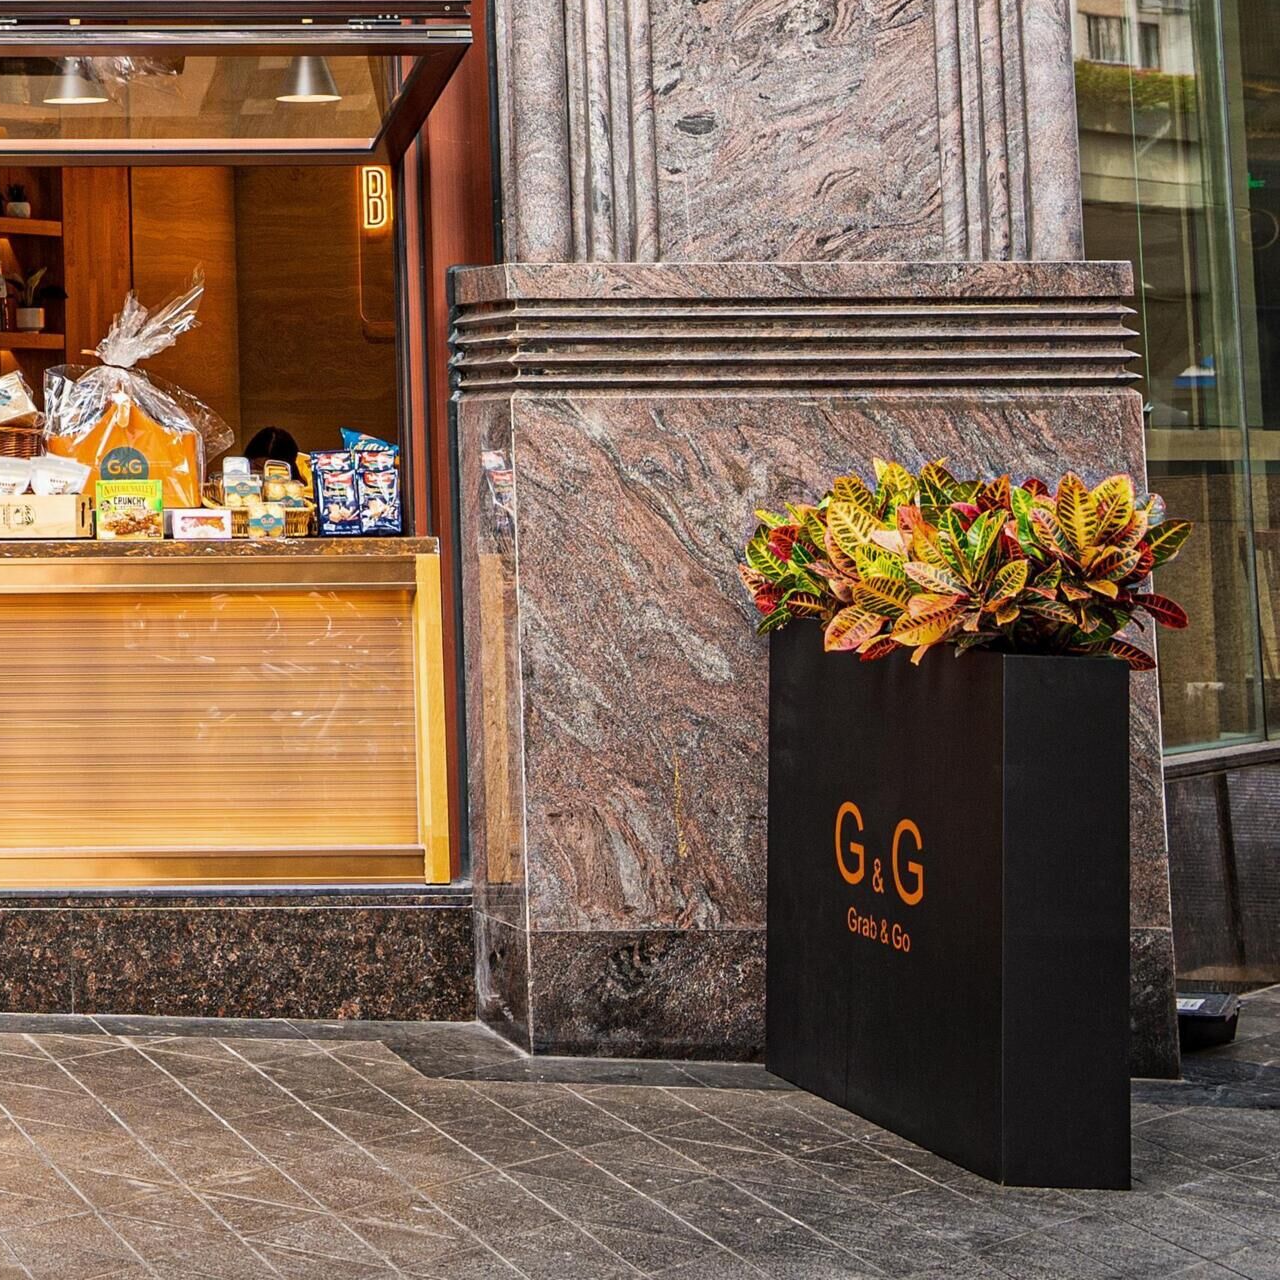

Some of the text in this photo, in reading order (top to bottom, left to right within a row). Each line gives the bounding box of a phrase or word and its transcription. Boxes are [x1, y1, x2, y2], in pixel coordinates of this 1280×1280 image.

[362, 166, 387, 229] B
[113, 496, 146, 509] CRUNCHY
[847, 906, 911, 952] Grab & Go
